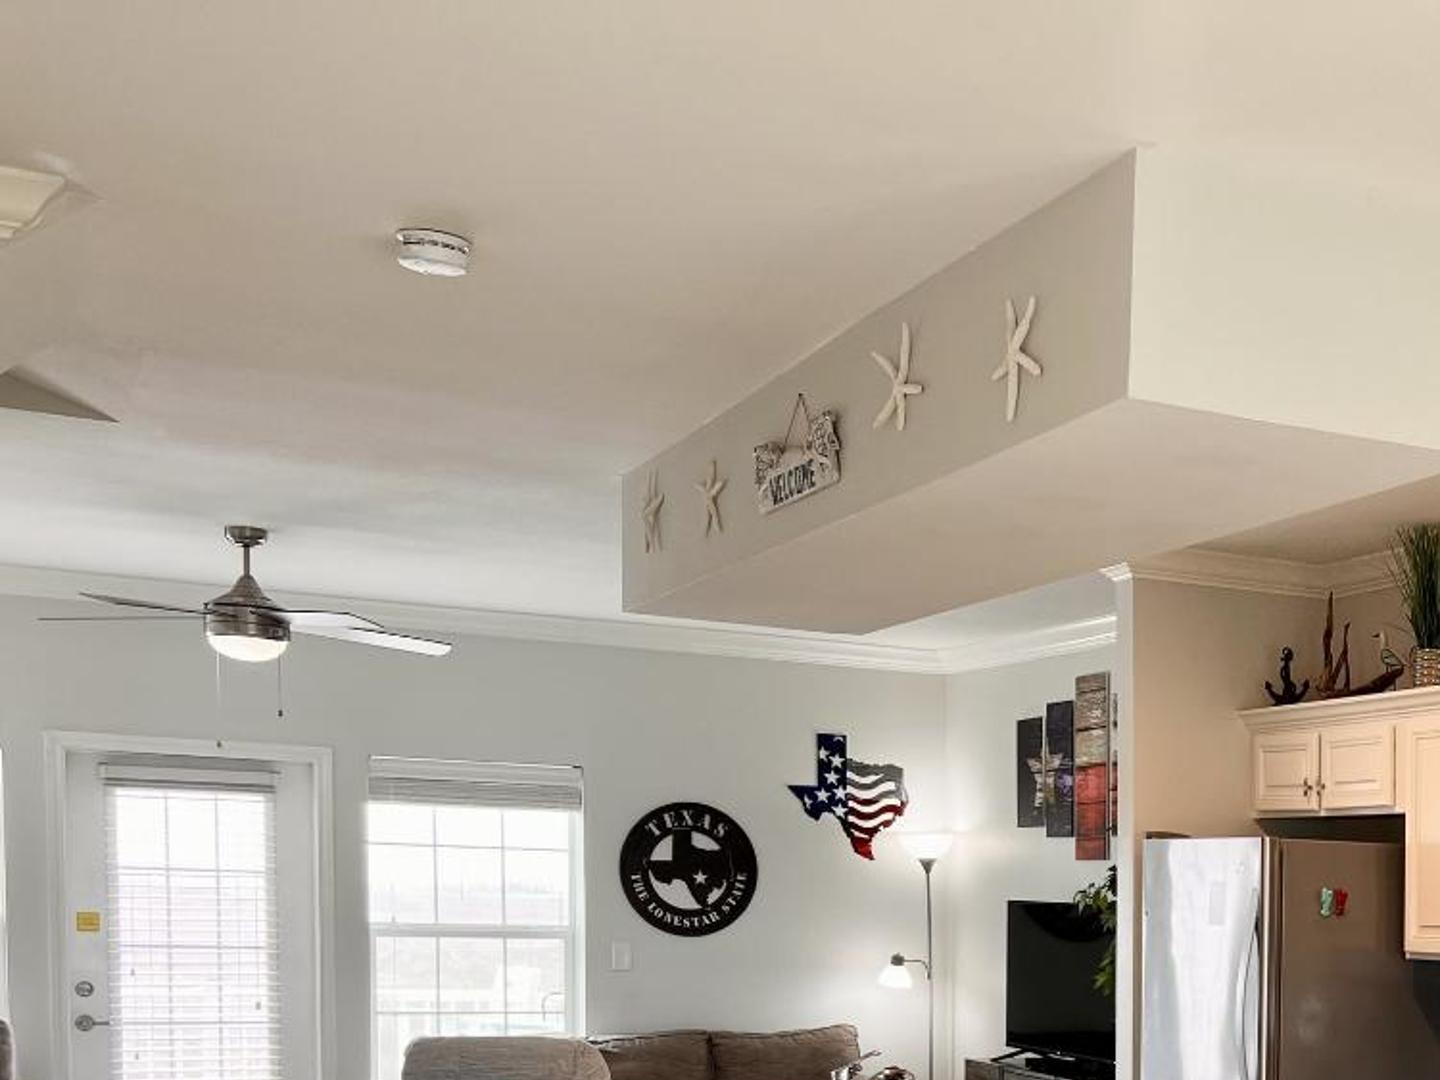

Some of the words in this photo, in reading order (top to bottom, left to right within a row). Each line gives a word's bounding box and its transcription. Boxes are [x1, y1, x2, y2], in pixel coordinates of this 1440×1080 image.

[769, 461, 816, 505] WELCOME
[644, 808, 730, 839] TEXAS
[629, 871, 651, 902] THE
[646, 901, 722, 929] LONESTAR
[720, 871, 748, 916] STATE
